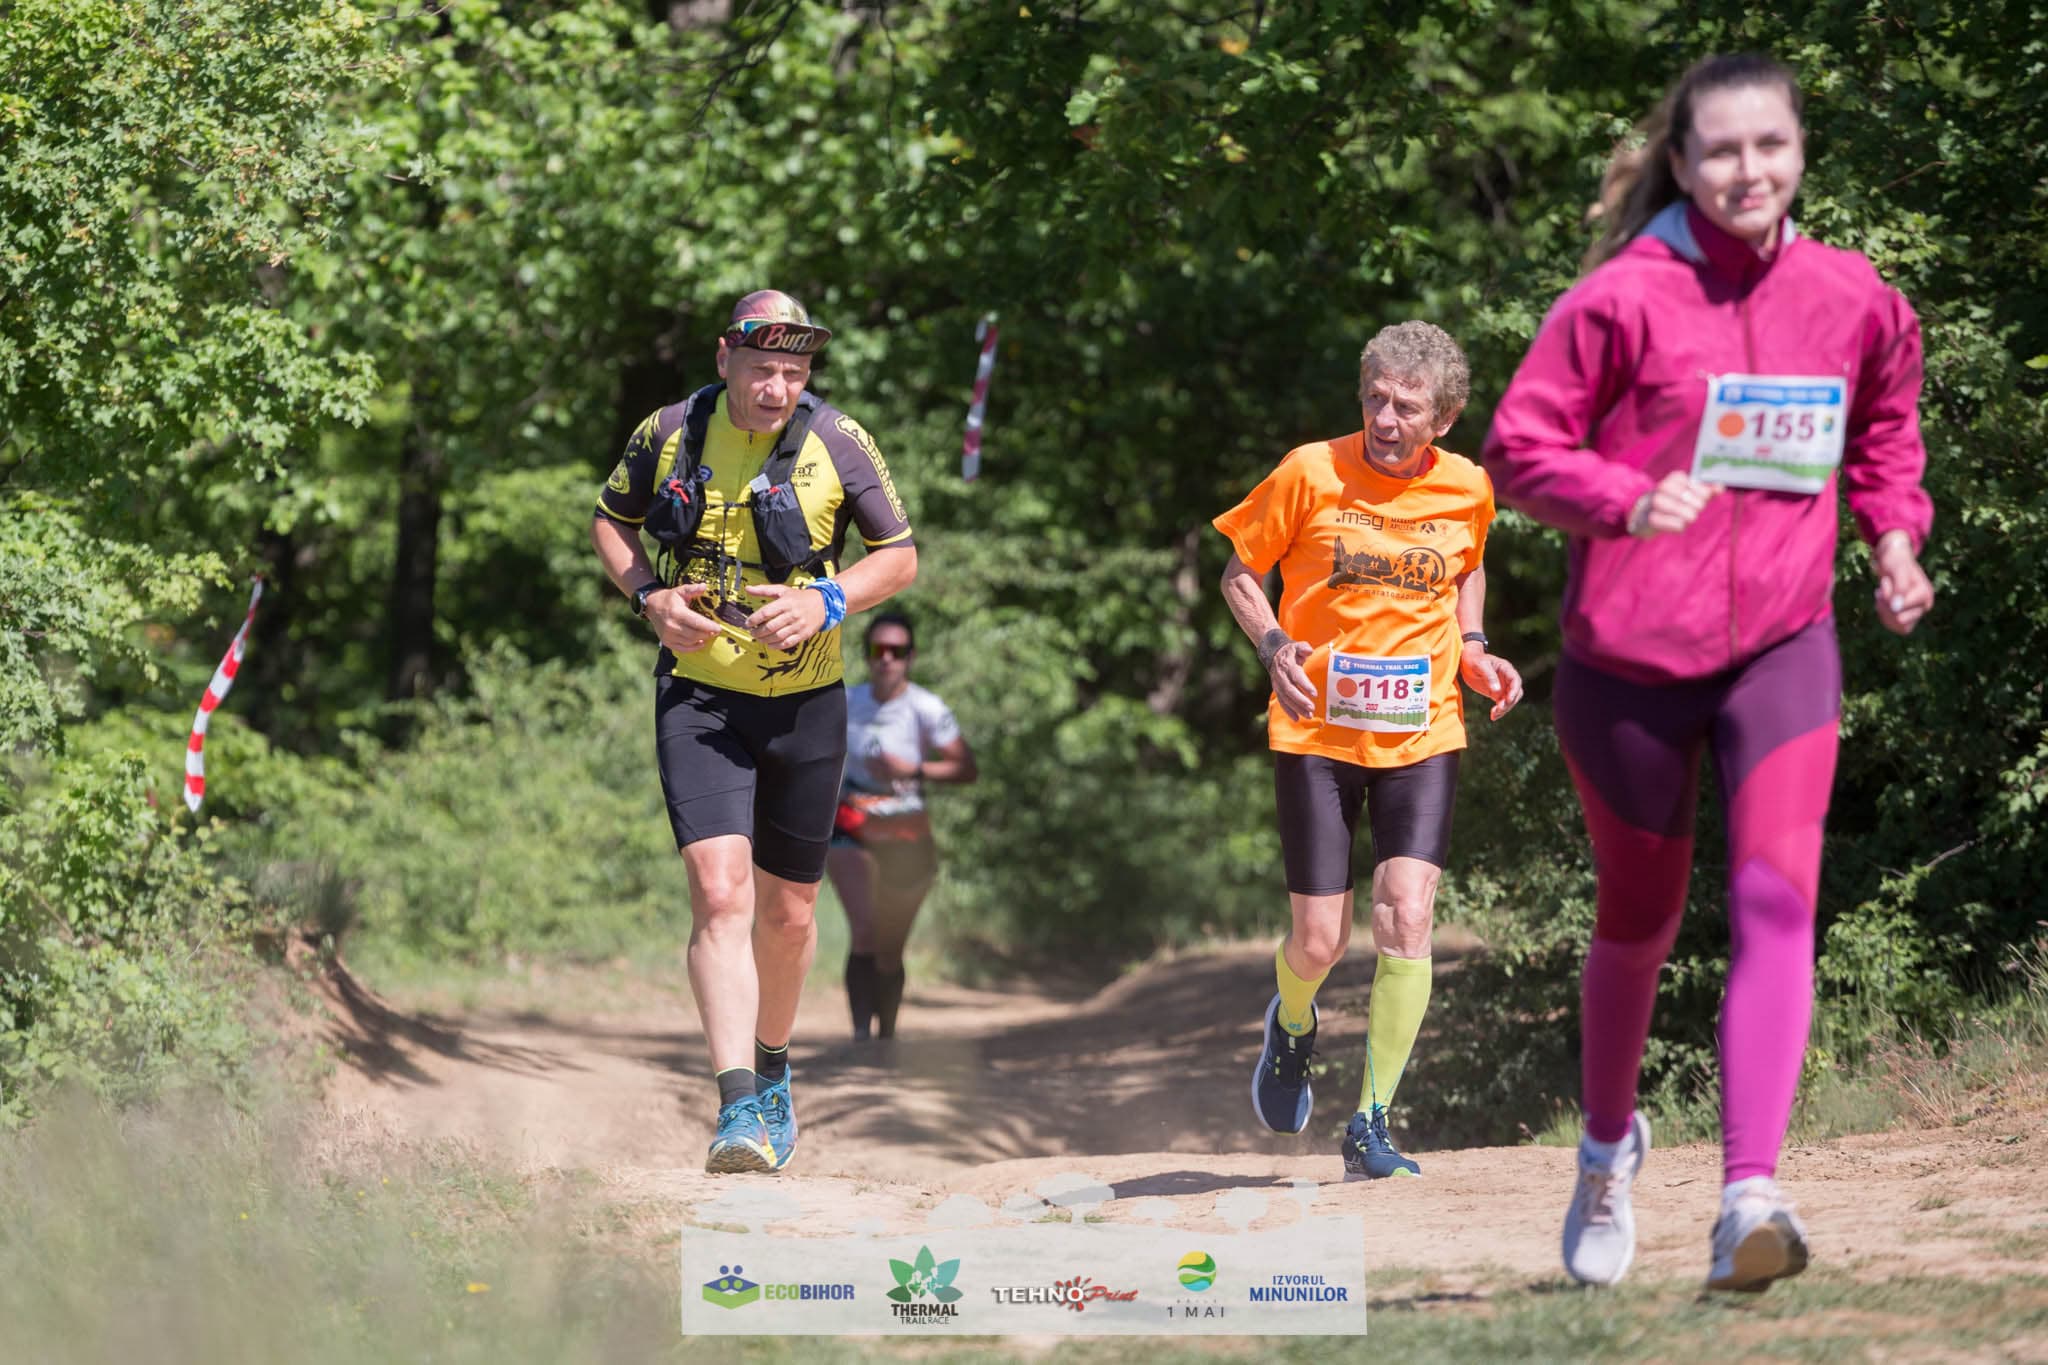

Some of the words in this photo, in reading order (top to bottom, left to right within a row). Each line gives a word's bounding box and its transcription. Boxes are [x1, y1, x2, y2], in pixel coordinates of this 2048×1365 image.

[763, 324, 812, 353] Buff
[1750, 411, 1815, 441] 155
[1336, 512, 1385, 531] .msg
[1353, 662, 1383, 671] THERMAL
[1385, 663, 1402, 671] TRAIL
[1359, 678, 1409, 700] 118
